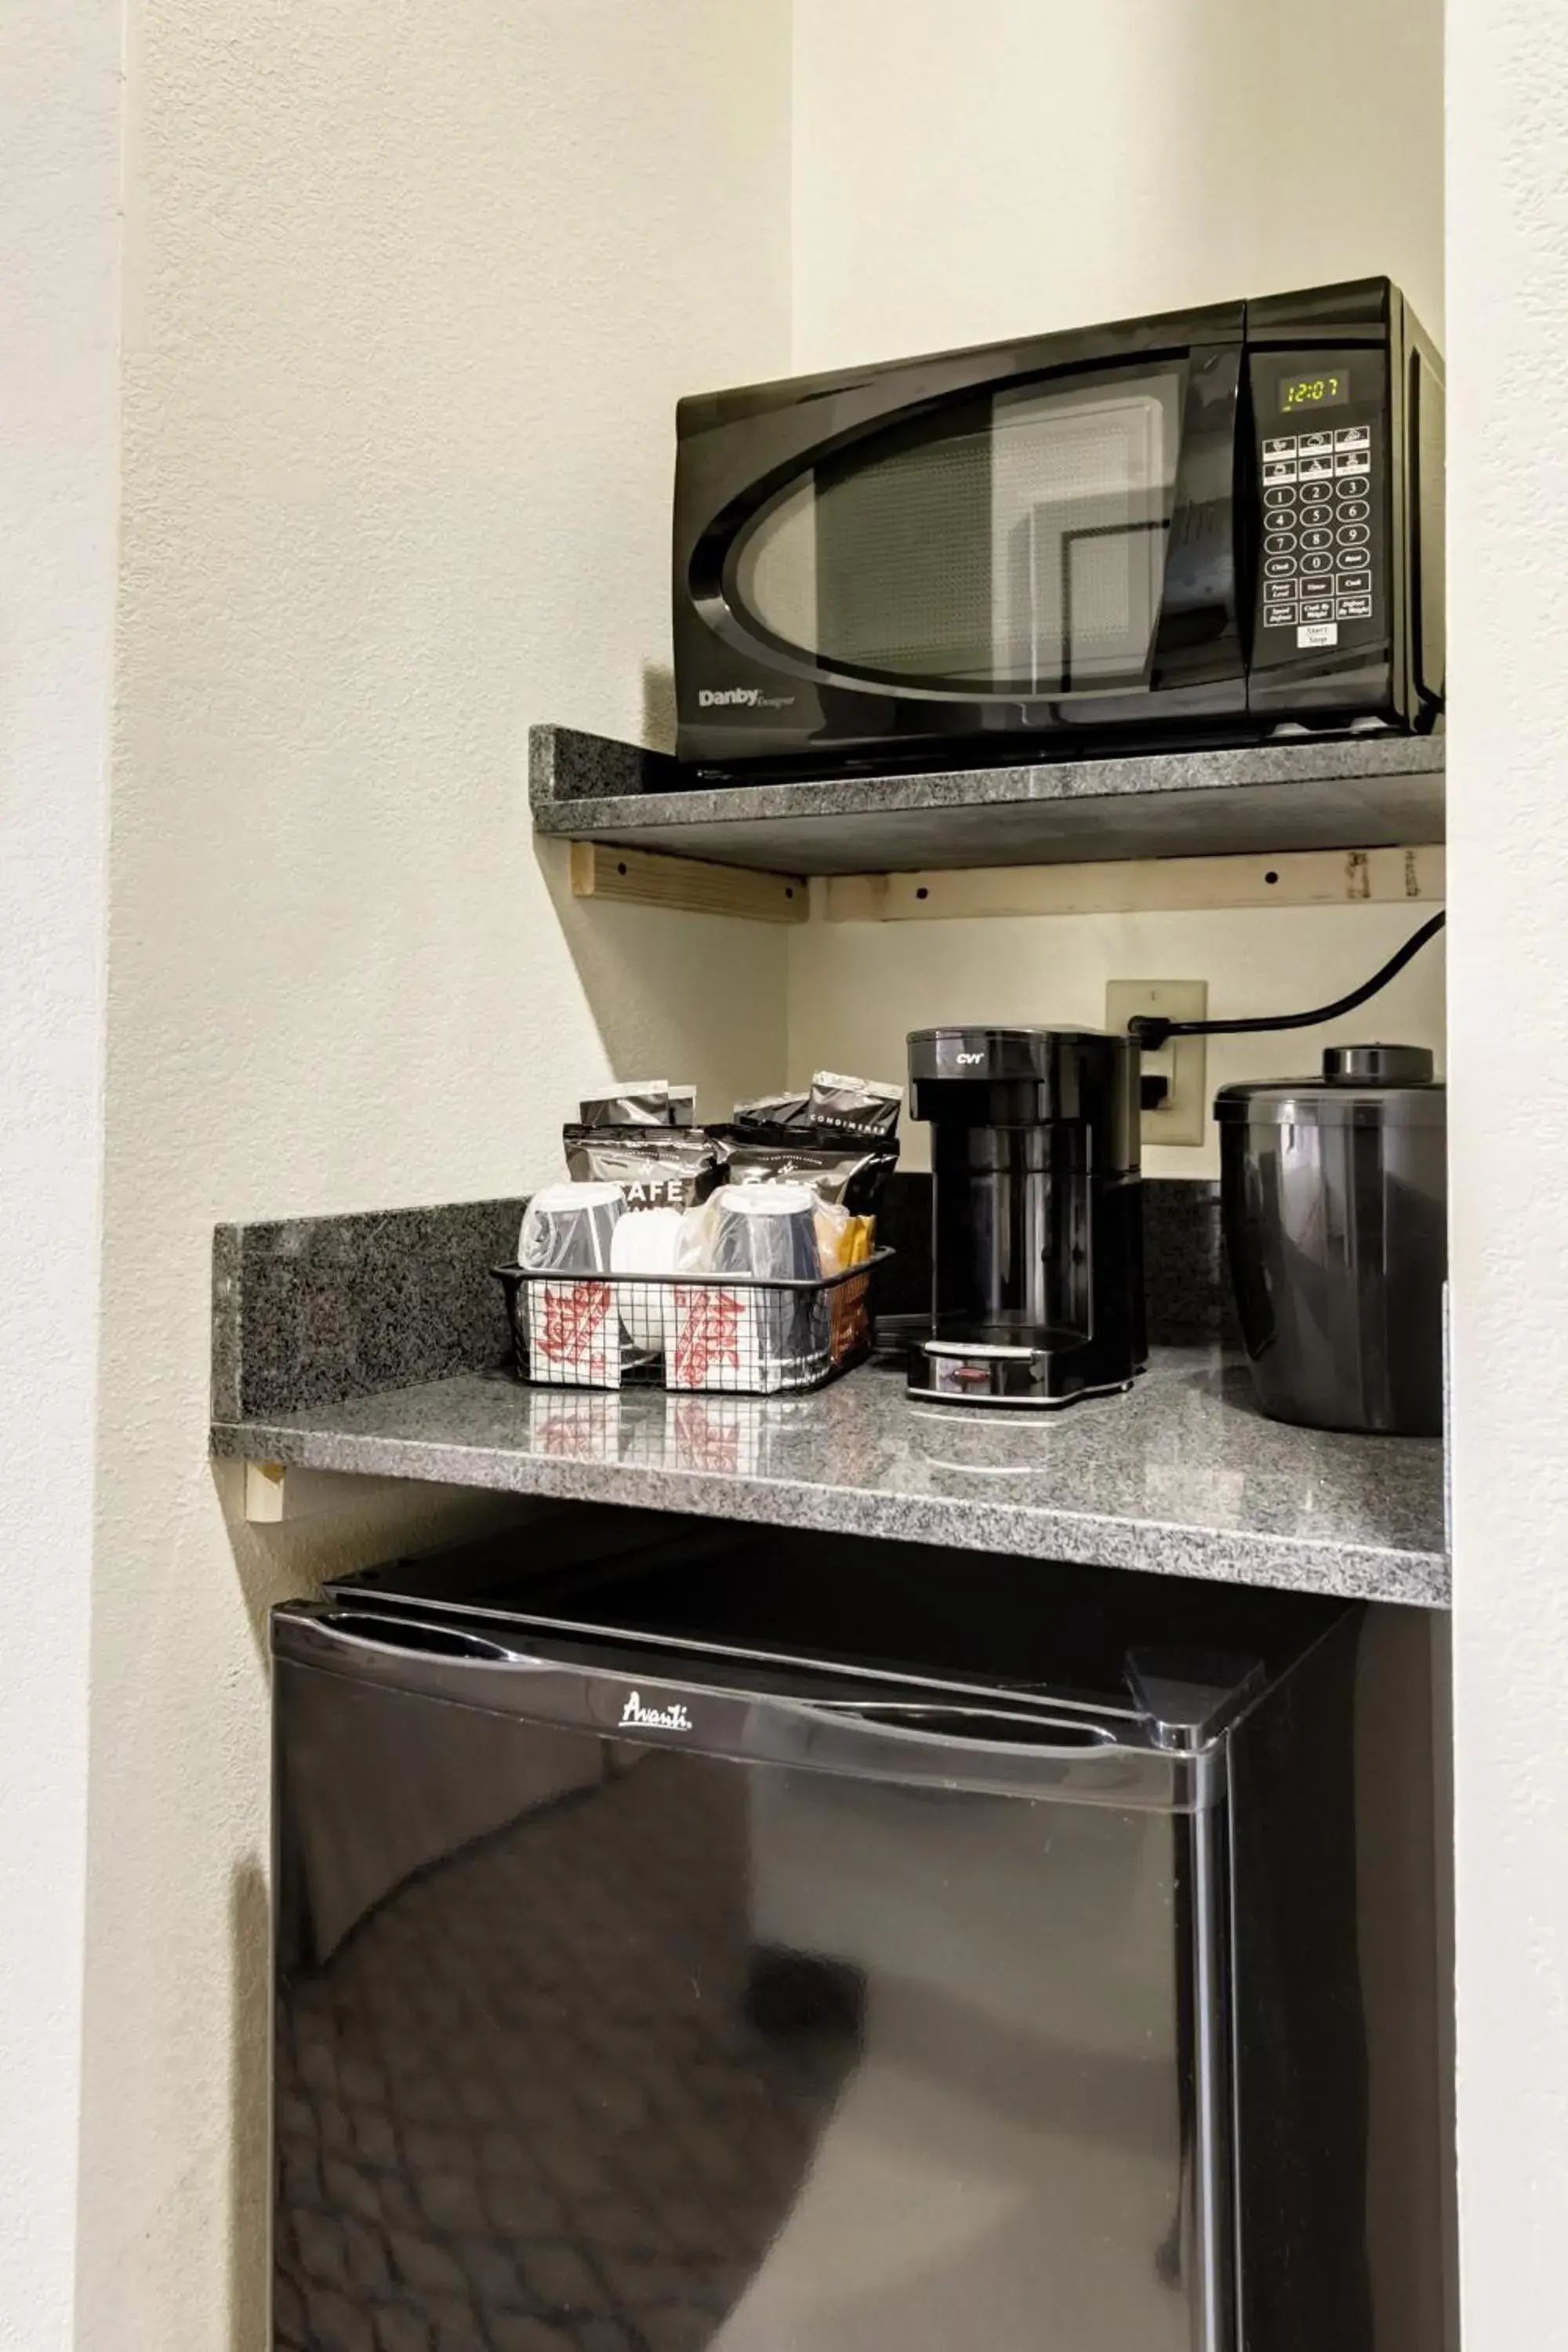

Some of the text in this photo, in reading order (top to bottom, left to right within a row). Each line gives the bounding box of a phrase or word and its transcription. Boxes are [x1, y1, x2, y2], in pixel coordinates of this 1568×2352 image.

[1287, 378, 1338, 402] 12:07
[1312, 487, 1320, 499] 2
[1348, 482, 1356, 494] 3
[1312, 510, 1320, 521] 5
[1348, 505, 1357, 517] 6
[1276, 514, 1284, 526] 4
[1312, 534, 1320, 545] 8
[1348, 528, 1358, 541] 9
[1276, 537, 1285, 550] 7
[1312, 557, 1321, 568] 0
[699, 687, 759, 707] Danby
[622, 1180, 684, 1202] AFE
[619, 1690, 690, 1730] Avanti
